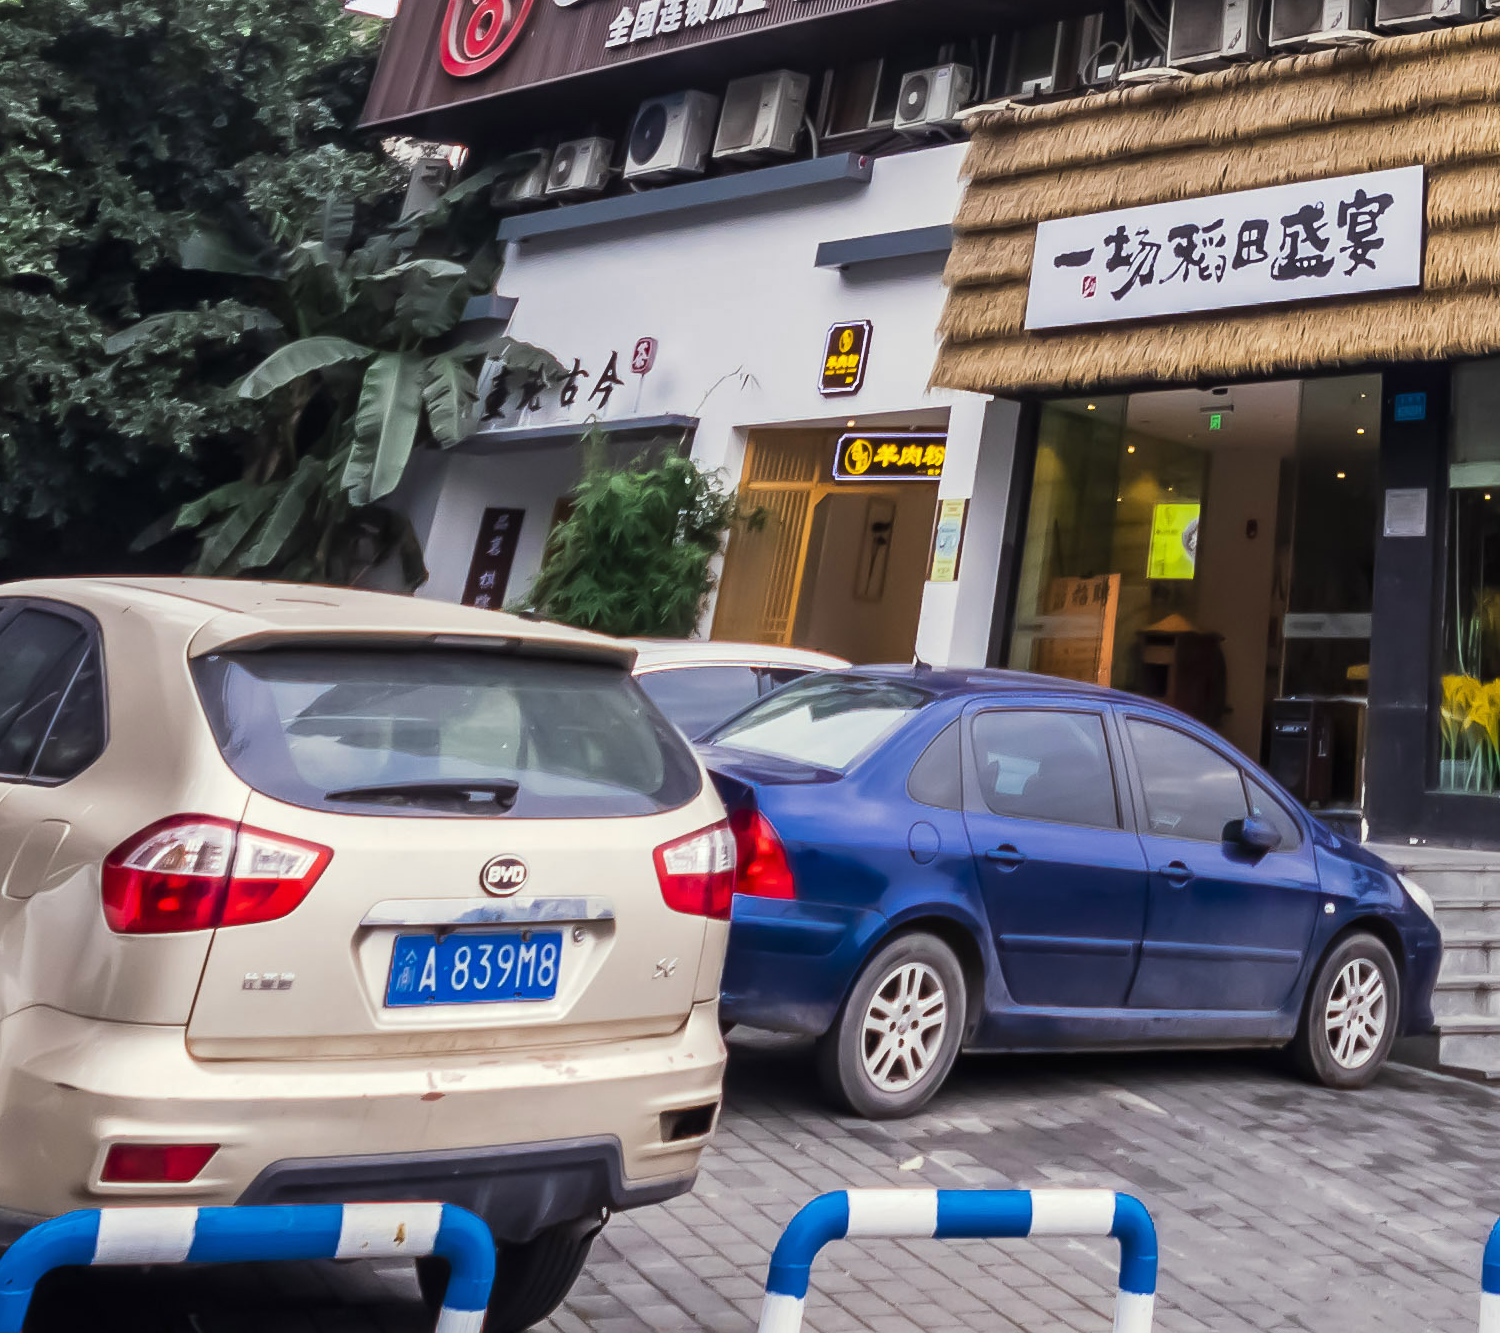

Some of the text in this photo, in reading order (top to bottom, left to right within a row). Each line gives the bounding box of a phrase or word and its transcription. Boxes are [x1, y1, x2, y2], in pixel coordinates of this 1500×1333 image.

[1053, 188, 1395, 301] 一场稻田盛宴
[873, 443, 946, 468] 羊肉粉
[486, 864, 526, 885] BYD
